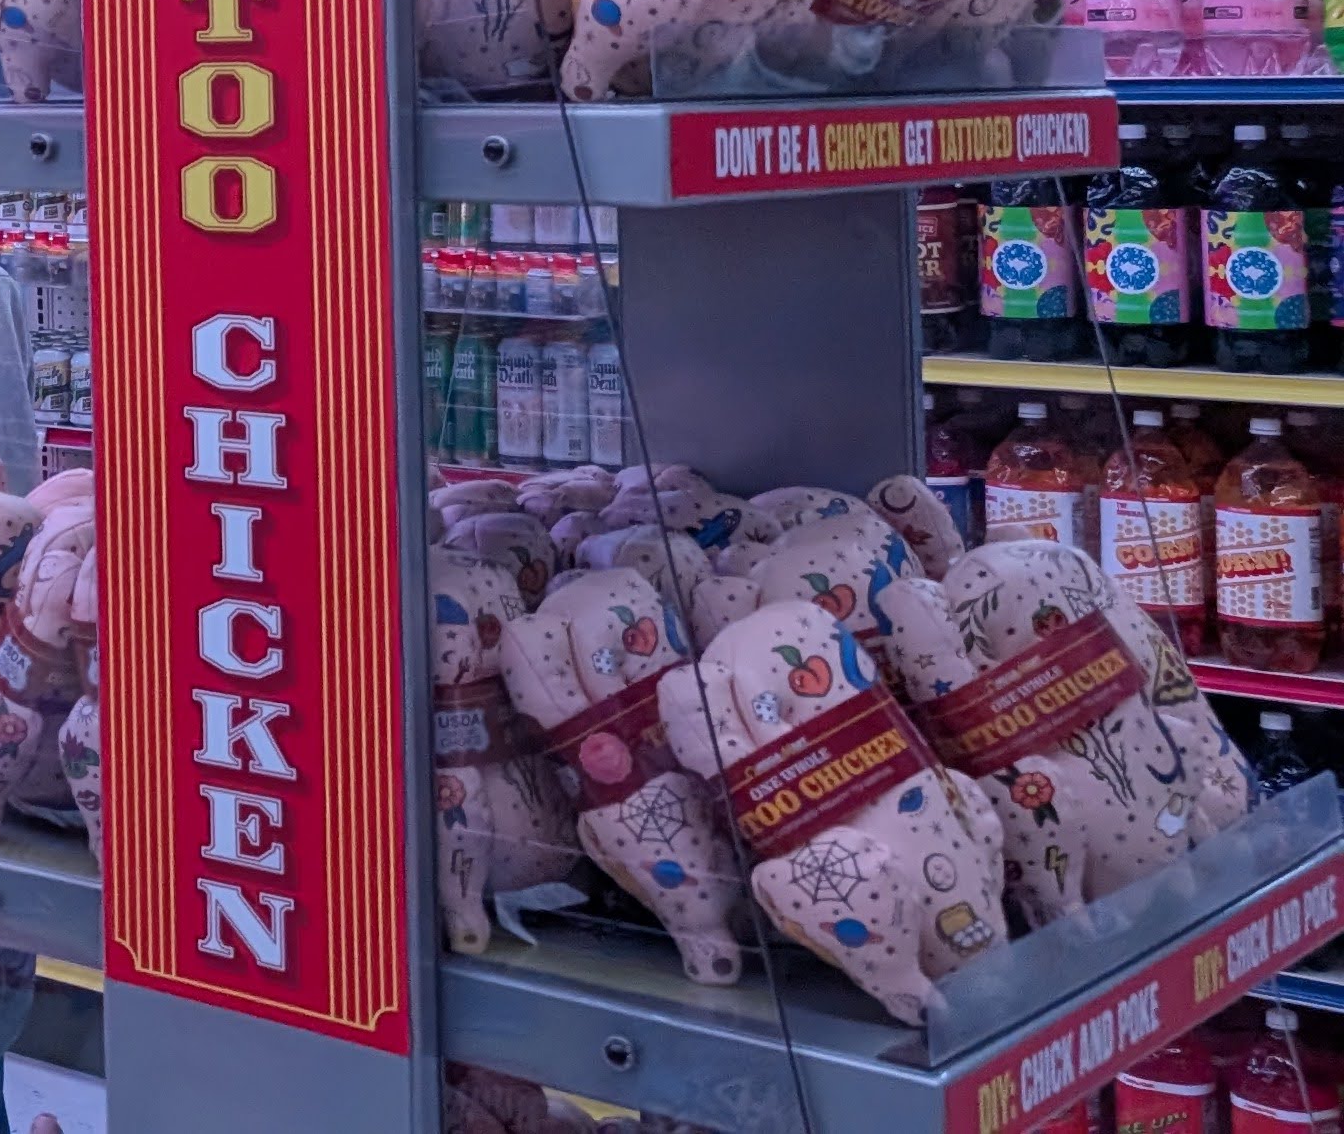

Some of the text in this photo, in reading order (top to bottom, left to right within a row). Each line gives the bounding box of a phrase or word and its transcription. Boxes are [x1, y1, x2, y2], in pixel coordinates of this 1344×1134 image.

[715, 112, 1090, 178] DON'T BE A CHICKEN GET TATTOOED (CHICKEN)
[1217, 549, 1293, 577] ORN!
[182, 312, 298, 974] CHICKEN
[437, 712, 481, 730] USDA
[799, 728, 908, 800] CHICKEN
[1227, 915, 1269, 982] CHICK
[1272, 898, 1301, 953] AND
[1304, 875, 1337, 935] POKE
[1020, 1032, 1075, 1113] CHICK
[1078, 1010, 1113, 1076] AND
[1117, 982, 1159, 1051] POKE
